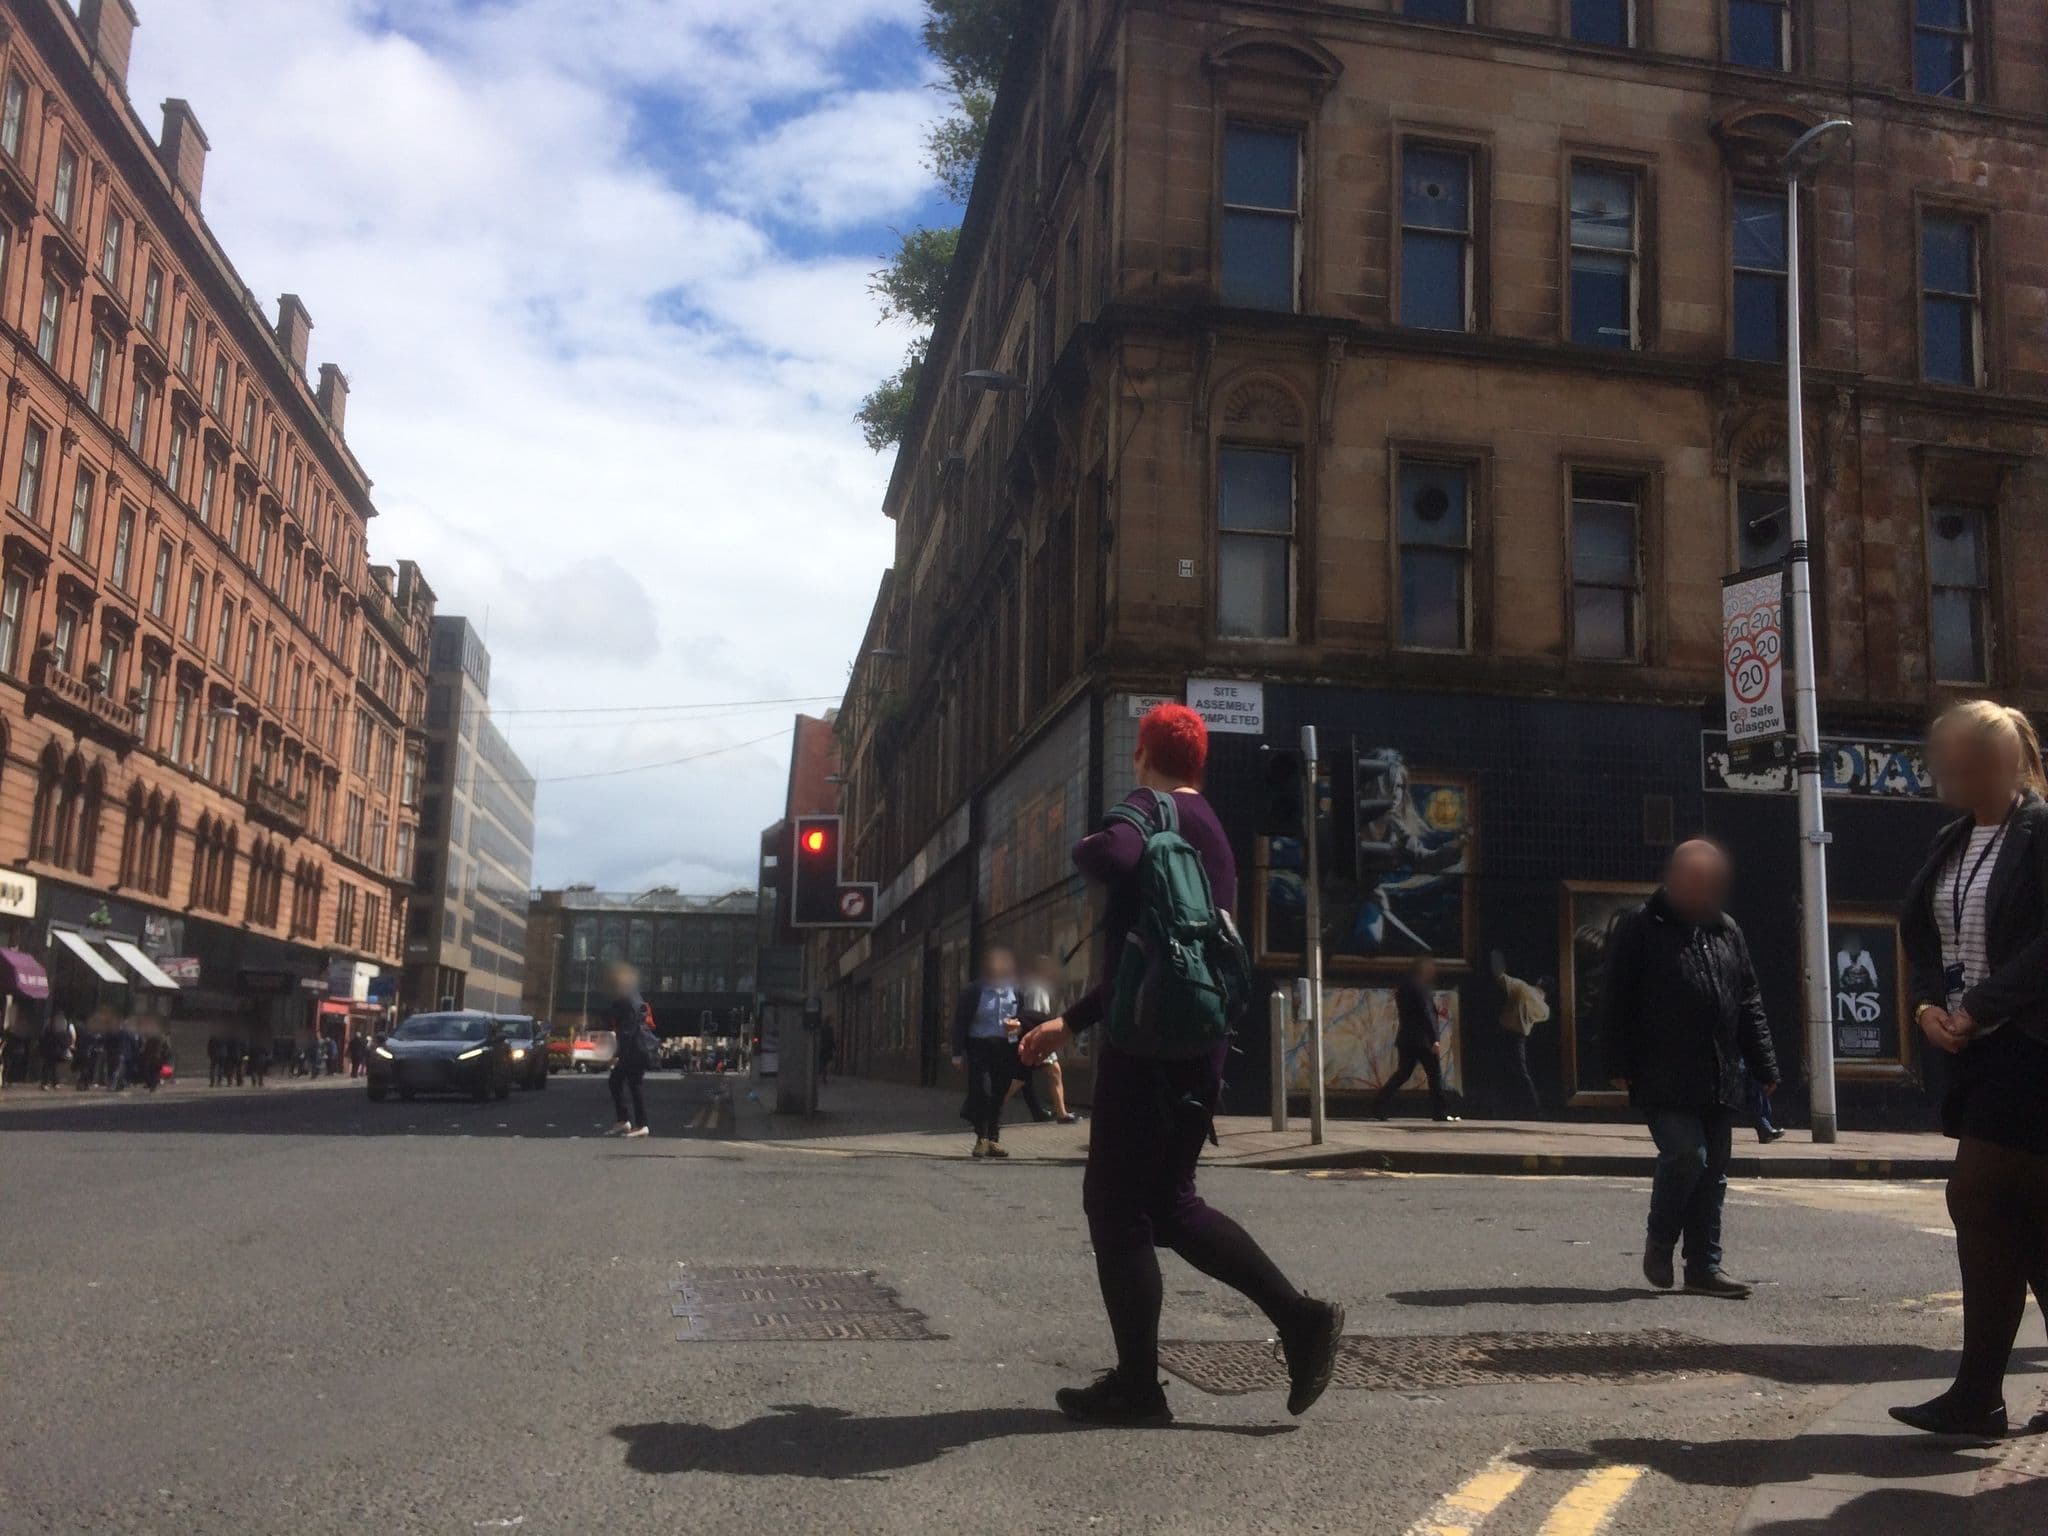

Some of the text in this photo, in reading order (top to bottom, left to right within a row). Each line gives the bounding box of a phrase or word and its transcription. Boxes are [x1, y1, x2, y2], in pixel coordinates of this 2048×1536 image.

[1751, 613, 1770, 628] 20
[1731, 622, 1749, 638] 20
[1756, 635, 1778, 657] 20
[1739, 665, 1763, 693] 20
[1214, 686, 1238, 697] SITE
[1196, 699, 1255, 712] ASSEMBLY
[1750, 704, 1774, 718] Safe
[1199, 713, 1260, 725] OMPLETED
[1734, 718, 1779, 734] Glasgow
